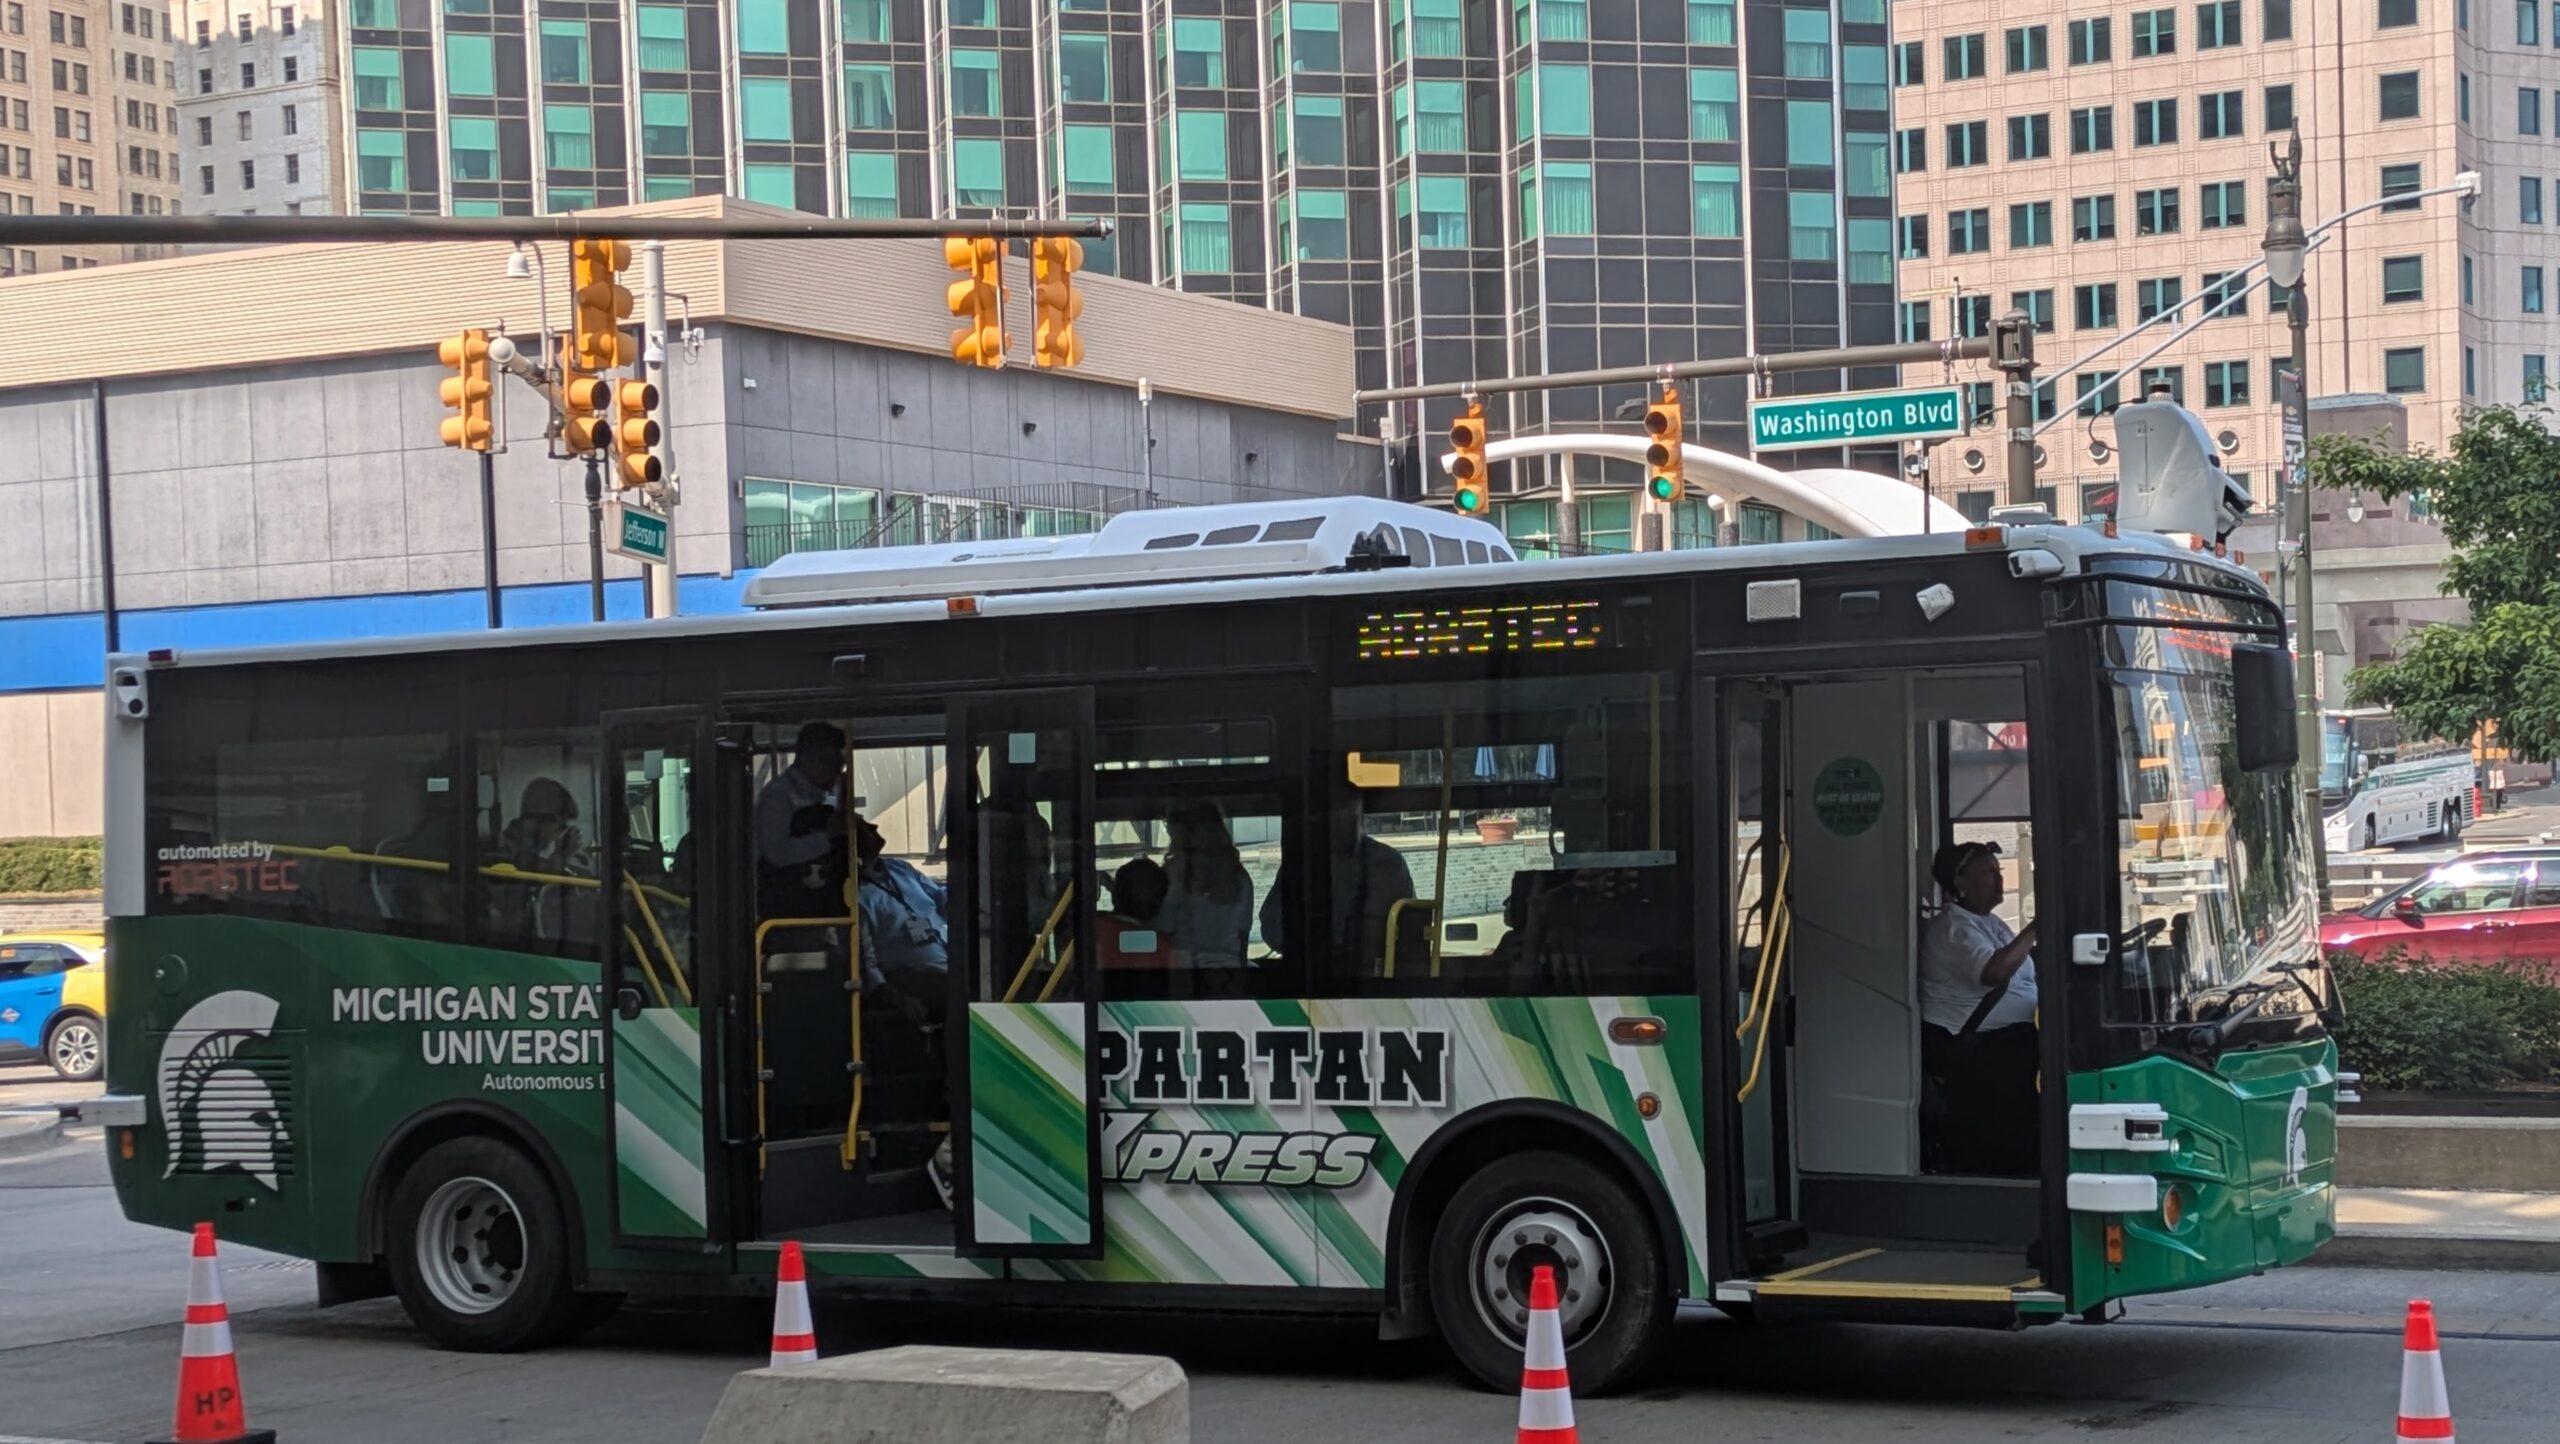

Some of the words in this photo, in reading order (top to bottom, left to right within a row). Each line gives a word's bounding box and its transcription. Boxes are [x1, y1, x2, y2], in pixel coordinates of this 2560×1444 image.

[1760, 408, 1893, 436] Washington
[1904, 400, 1953, 425] Blvd
[624, 520, 657, 547] Jefferson
[158, 841, 250, 860] automated
[253, 840, 274, 862] by
[332, 986, 516, 1022] MICHIGAN
[482, 1073, 594, 1090] Autonomous
